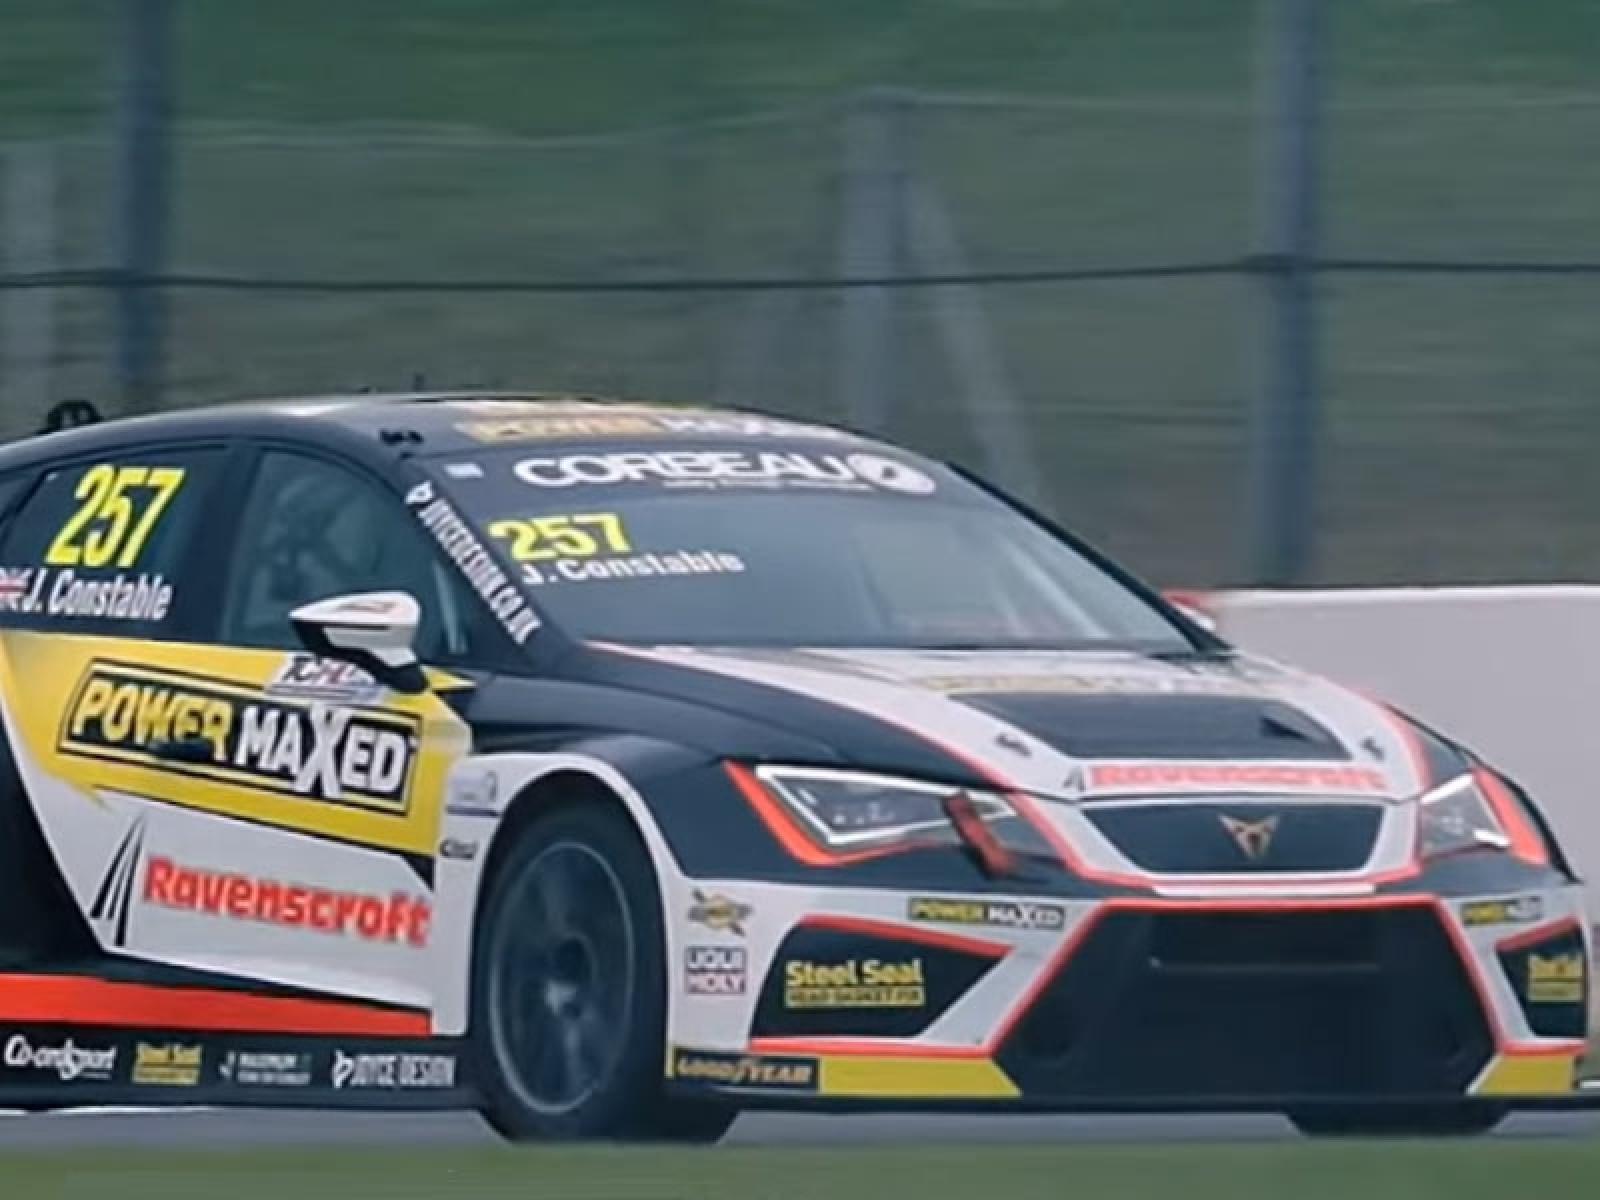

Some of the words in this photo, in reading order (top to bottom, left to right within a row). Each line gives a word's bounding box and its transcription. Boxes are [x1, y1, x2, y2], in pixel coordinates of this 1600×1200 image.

[513, 451, 856, 488] CORBEAU
[44, 463, 186, 568] 257
[488, 512, 632, 560] 257
[557, 550, 745, 581] Constable
[48, 567, 173, 620] Constable
[71, 679, 233, 763] POWER
[236, 702, 407, 799] MAXED
[143, 855, 432, 947] Ravenscroft
[785, 959, 858, 987] Steel
[862, 957, 923, 984] Seal
